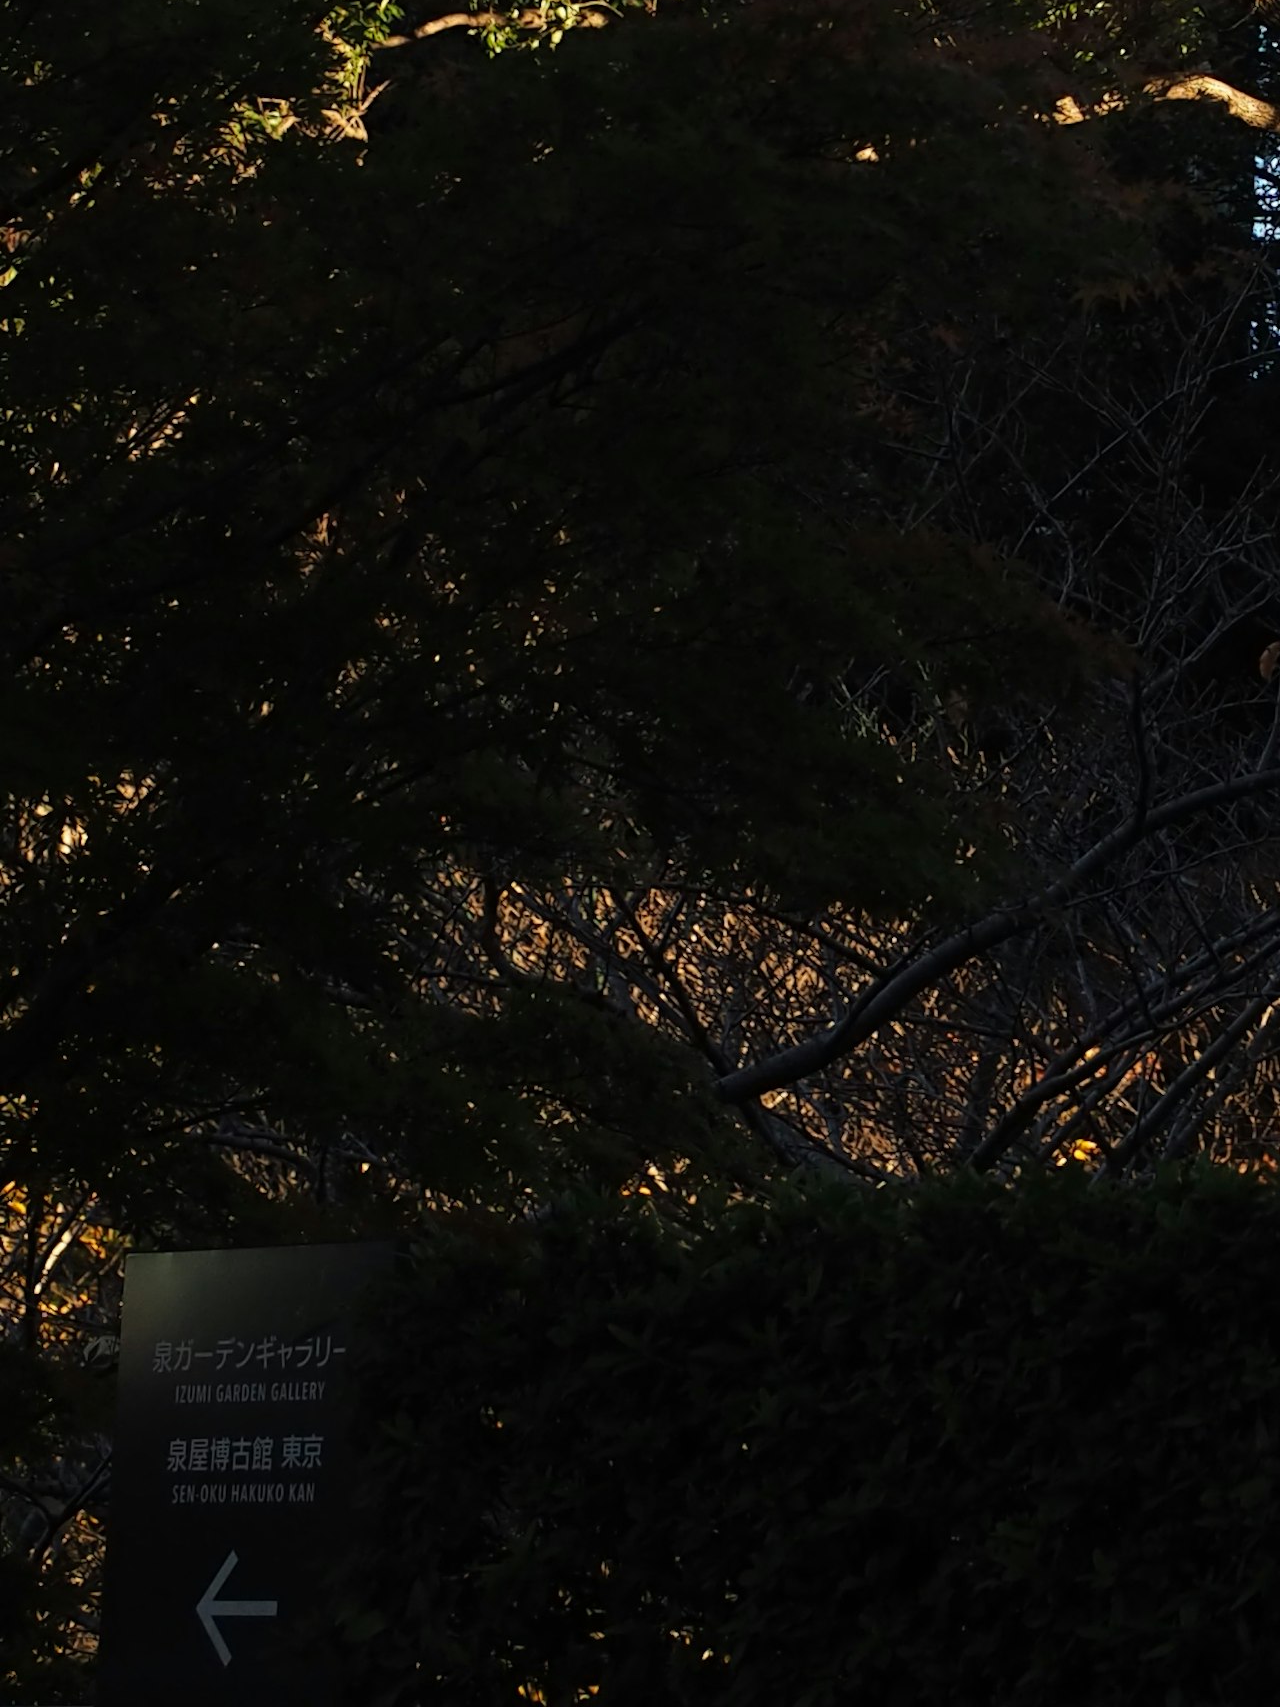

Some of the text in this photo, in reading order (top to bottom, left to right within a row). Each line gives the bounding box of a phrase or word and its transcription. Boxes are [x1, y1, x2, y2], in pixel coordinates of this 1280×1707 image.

[153, 1335, 346, 1373] 泉ガーデンギャラリー
[174, 1381, 326, 1404] IZUMI GARDEN GALLERY
[166, 1434, 325, 1472] 泉屋博古館 東京
[171, 1482, 315, 1505] SEN-OKU HAKUKO KAN
